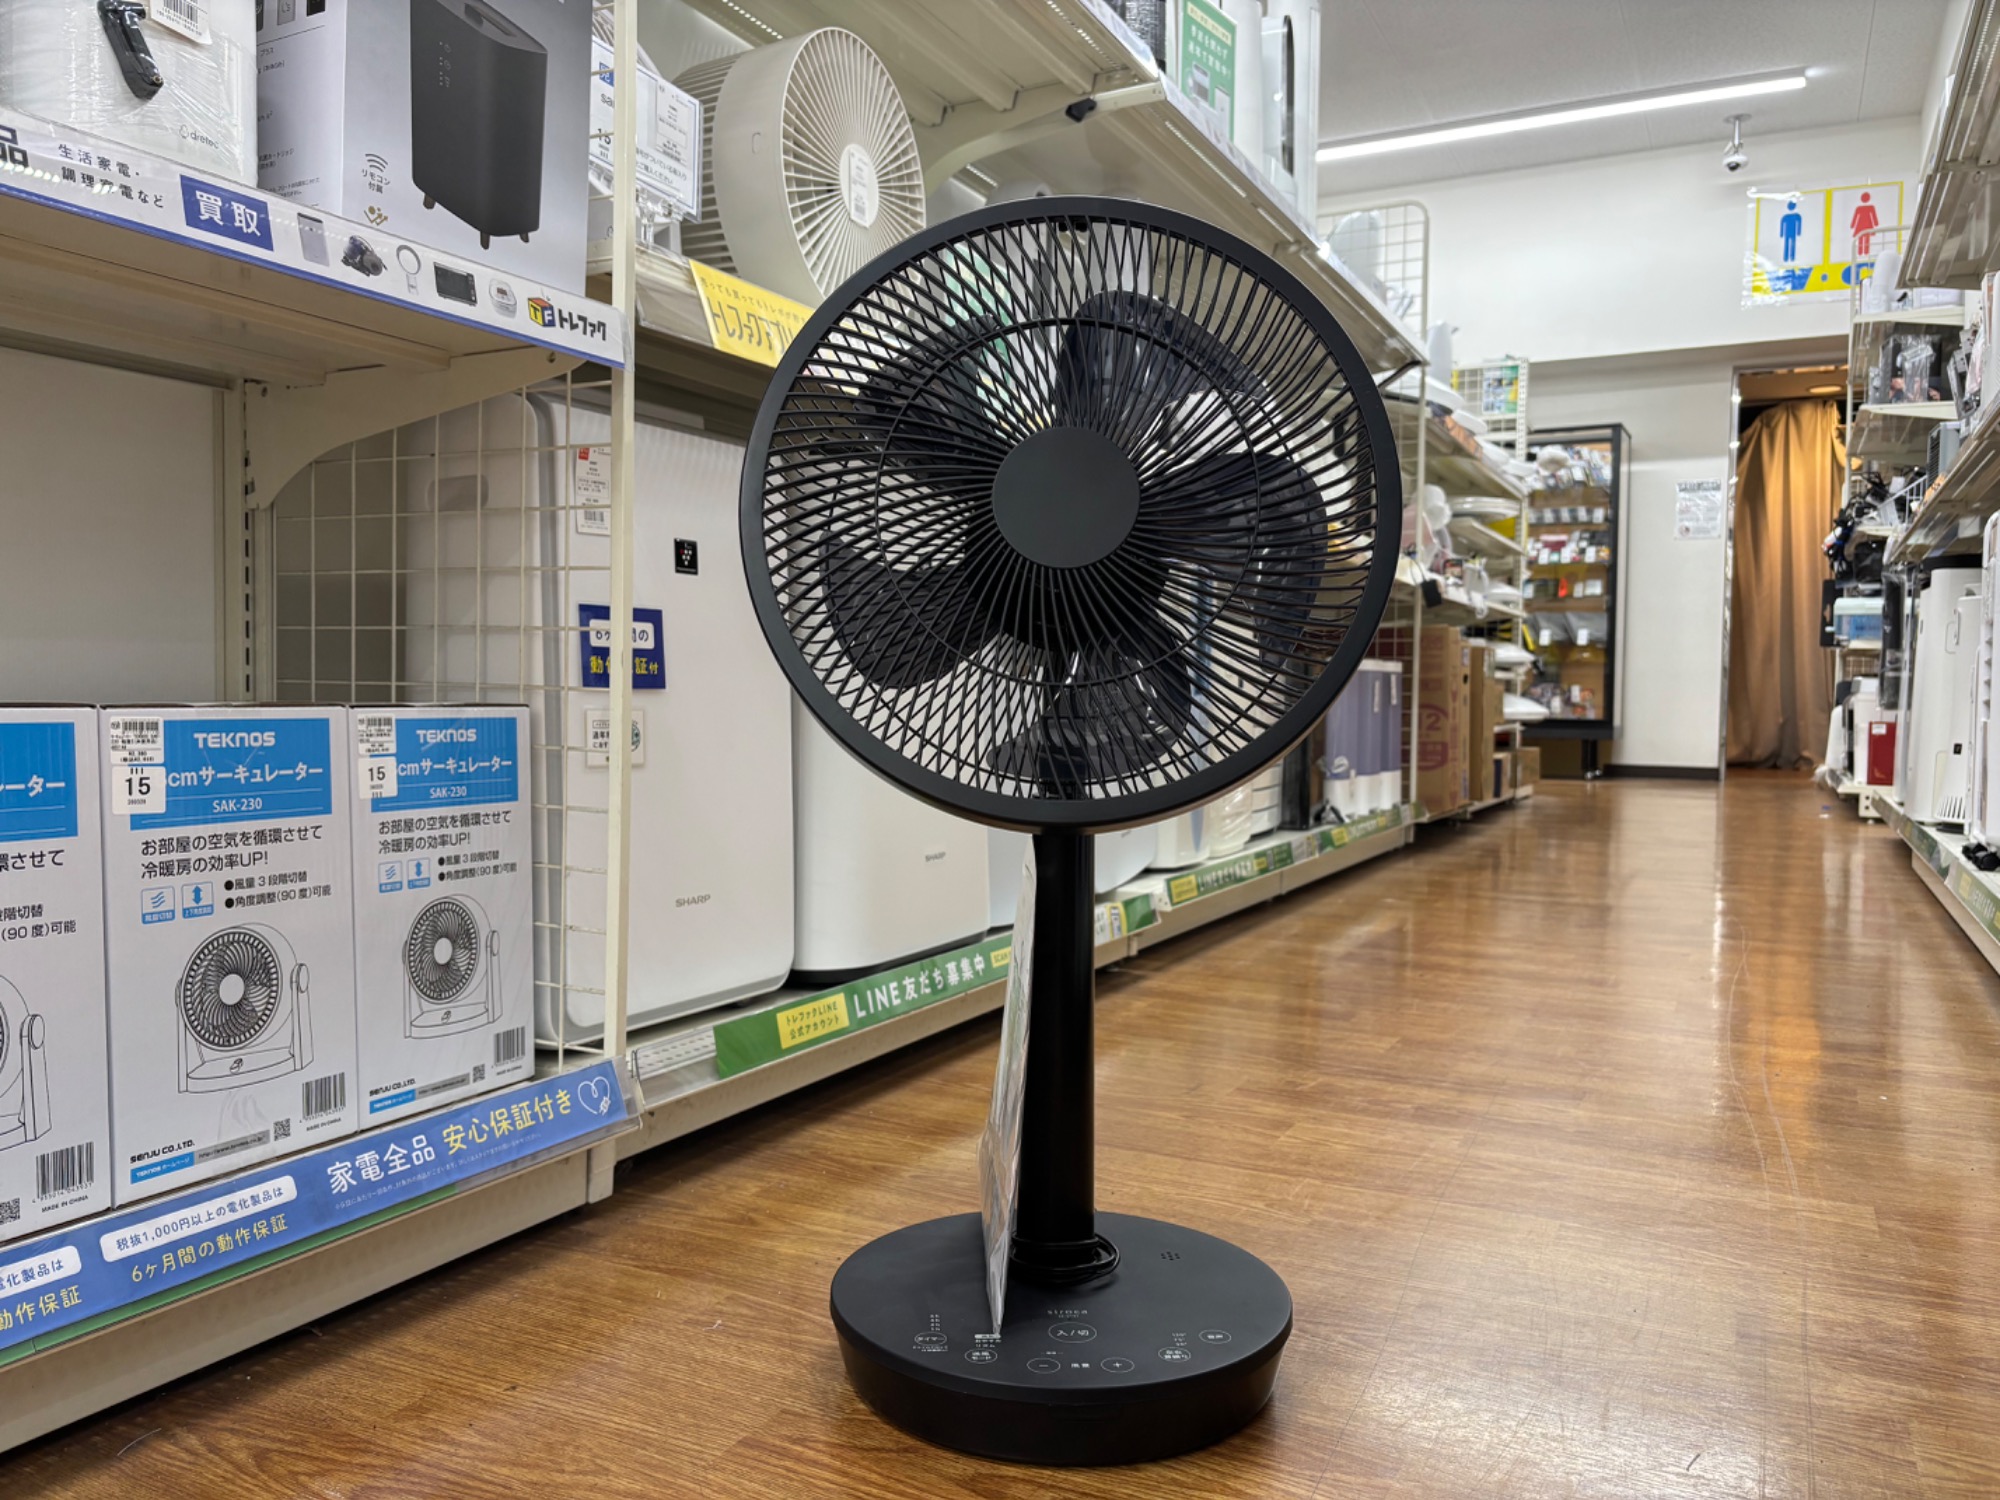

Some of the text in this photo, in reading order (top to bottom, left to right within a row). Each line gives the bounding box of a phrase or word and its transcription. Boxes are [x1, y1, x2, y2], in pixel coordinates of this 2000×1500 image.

[361, 168, 391, 186] リモコン
[195, 190, 262, 237] 買取
[193, 731, 276, 749] TEKNOS
[416, 728, 477, 744] TEKNOS
[368, 766, 386, 782] 15
[0, 774, 66, 798] ーター
[125, 776, 151, 797] 15
[429, 785, 468, 799] SAK-230
[213, 797, 263, 814] SAK-230
[378, 810, 512, 835] お部屋の空気を循環させて
[141, 825, 323, 857] お部屋の空気を循環させて
[378, 832, 471, 855] 冷暖房の効率UP!
[141, 851, 269, 880] 冷暖房の効率UP!
[925, 851, 946, 862] SHARP
[675, 893, 711, 908] SHARP
[853, 953, 985, 1019] LINE友だち募集中
[789, 1015, 840, 1040] 公式アカウント
[327, 1088, 573, 1195] 家電全品 安心保証付き
[41, 1194, 89, 1213] MADE IN CHINA
[116, 1186, 284, 1251] 税抜1,000円以上の電化製品は
[131, 1213, 289, 1283] 6ヶ月間の動作保証
